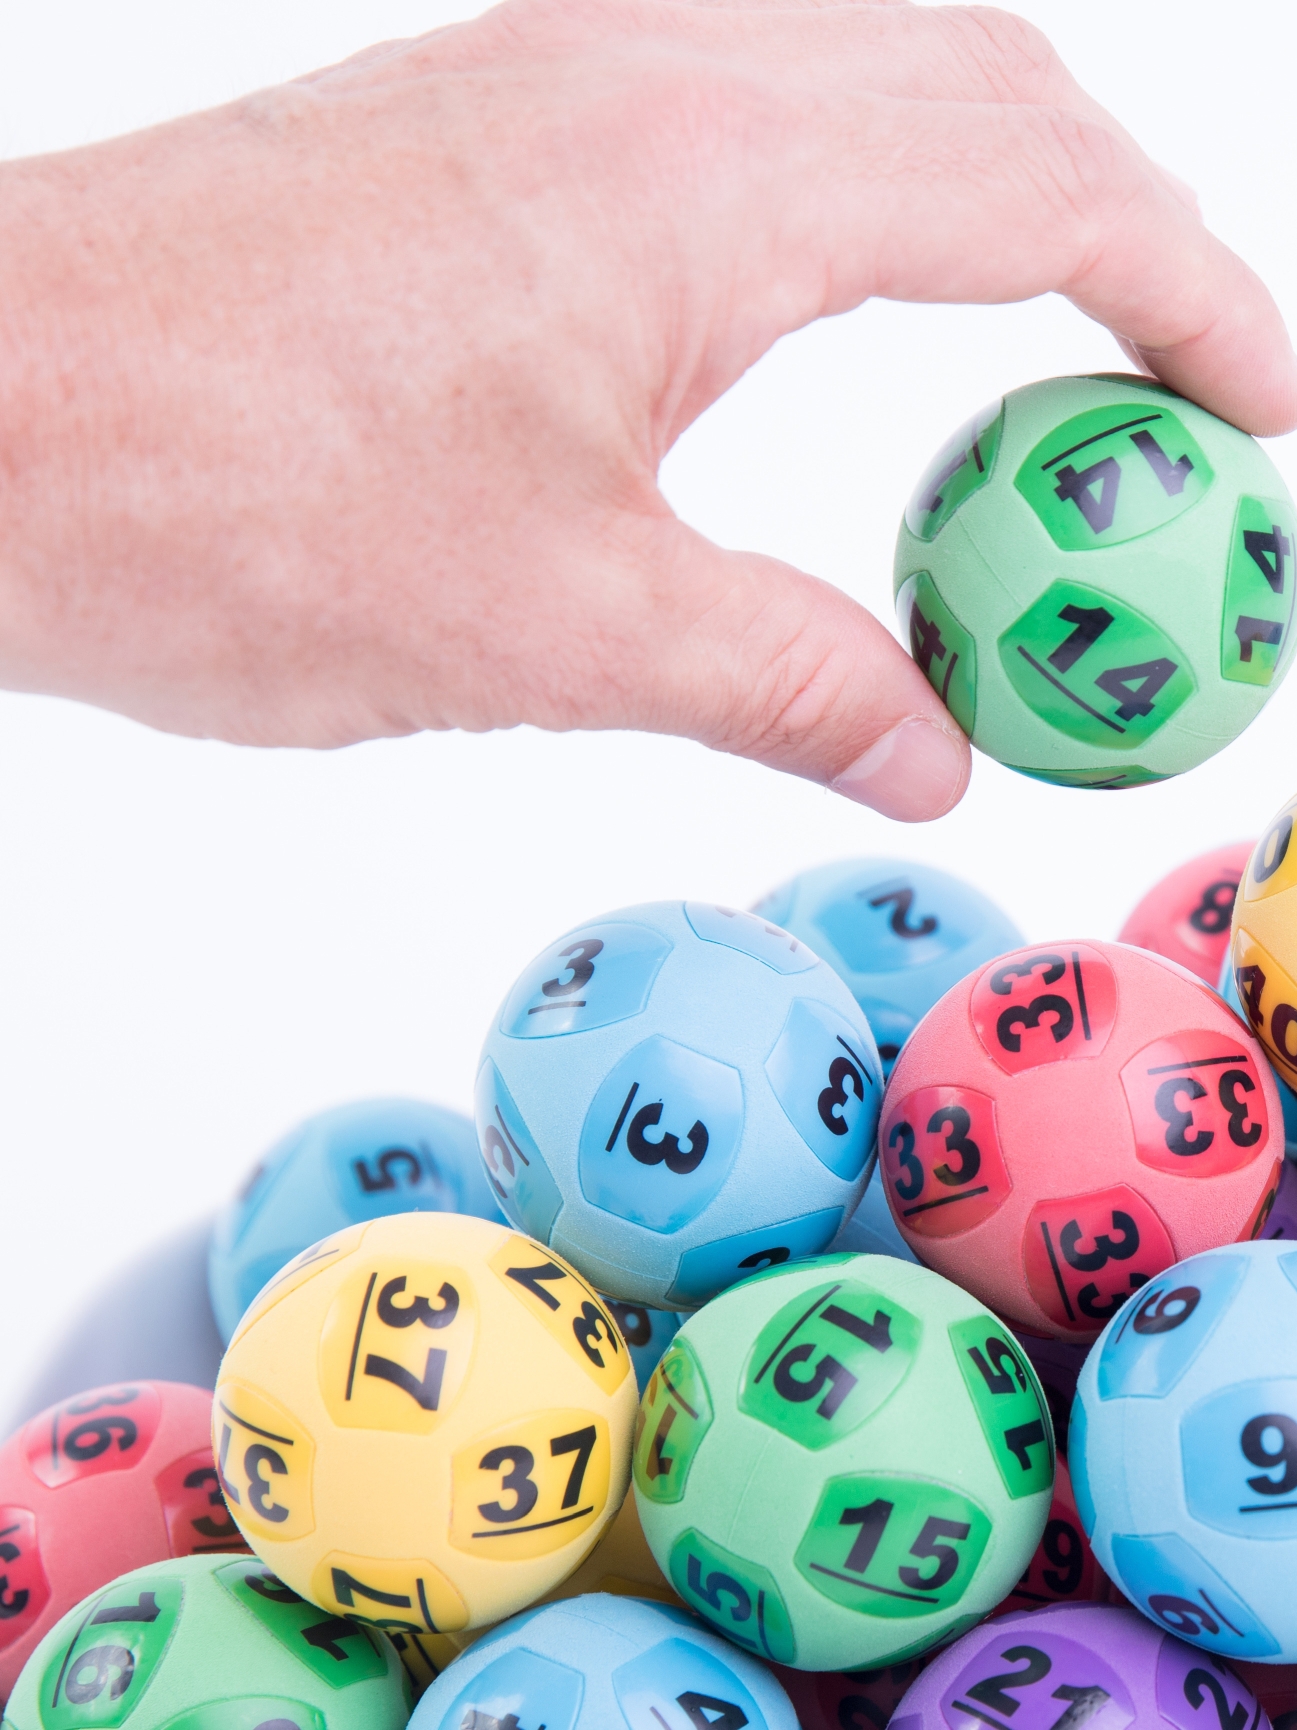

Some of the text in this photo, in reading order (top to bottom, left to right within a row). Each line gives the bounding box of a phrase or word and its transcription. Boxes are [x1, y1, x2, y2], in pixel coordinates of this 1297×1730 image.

[1054, 430, 1195, 534] 14
[1234, 525, 1291, 663] 14
[1046, 603, 1178, 722] 14
[868, 885, 939, 940] 2
[541, 938, 605, 998] 3
[989, 953, 1075, 1054] 33
[626, 1101, 710, 1176] 3
[816, 1055, 865, 1137] 3
[1154, 1068, 1263, 1157] 33
[352, 1147, 424, 1194] 5
[888, 1105, 981, 1201] 33
[364, 1273, 461, 1412] 37
[504, 1261, 618, 1369] 37
[1131, 1285, 1202, 1336] 9
[772, 1303, 894, 1421] 15
[966, 1336, 1046, 1473] 15
[63, 1387, 139, 1462] 36
[216, 1422, 291, 1525] 37
[476, 1424, 598, 1524] 37
[838, 1498, 972, 1591] 15
[64, 1591, 162, 1706] 16
[1146, 1593, 1221, 1636] 9
